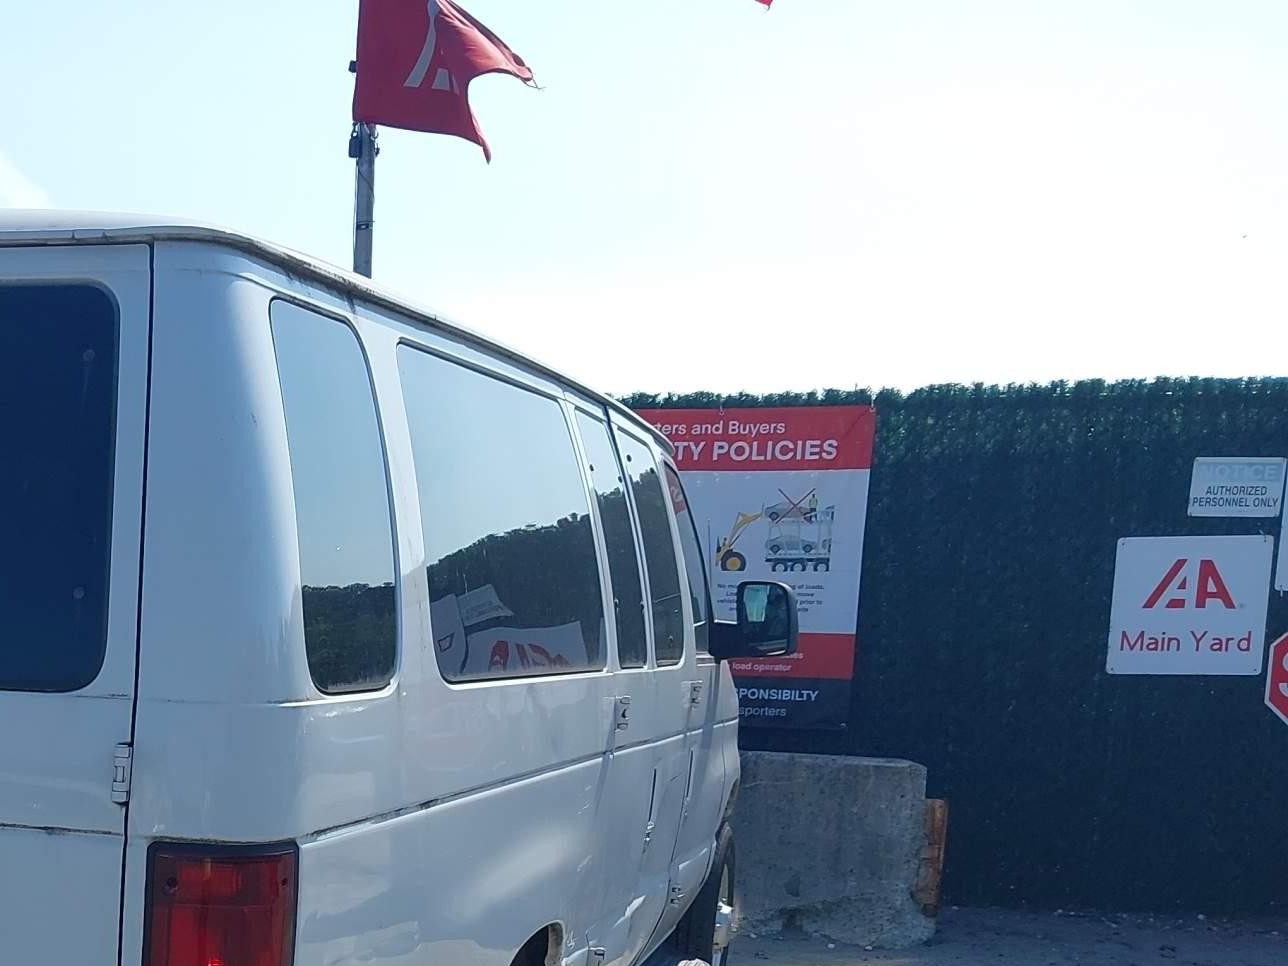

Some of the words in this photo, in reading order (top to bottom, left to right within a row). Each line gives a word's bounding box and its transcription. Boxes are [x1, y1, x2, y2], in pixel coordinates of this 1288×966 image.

[691, 420, 723, 435] and
[728, 420, 786, 438] Buyers
[712, 439, 838, 461] POLICIES
[1205, 485, 1268, 496] AUTHORIZED
[1192, 496, 1250, 508] PERSONNEL
[1252, 497, 1279, 508] ONLY
[1119, 630, 1181, 652] Main
[1190, 630, 1253, 652] Yard
[732, 662, 752, 670] load
[753, 664, 792, 672] operator
